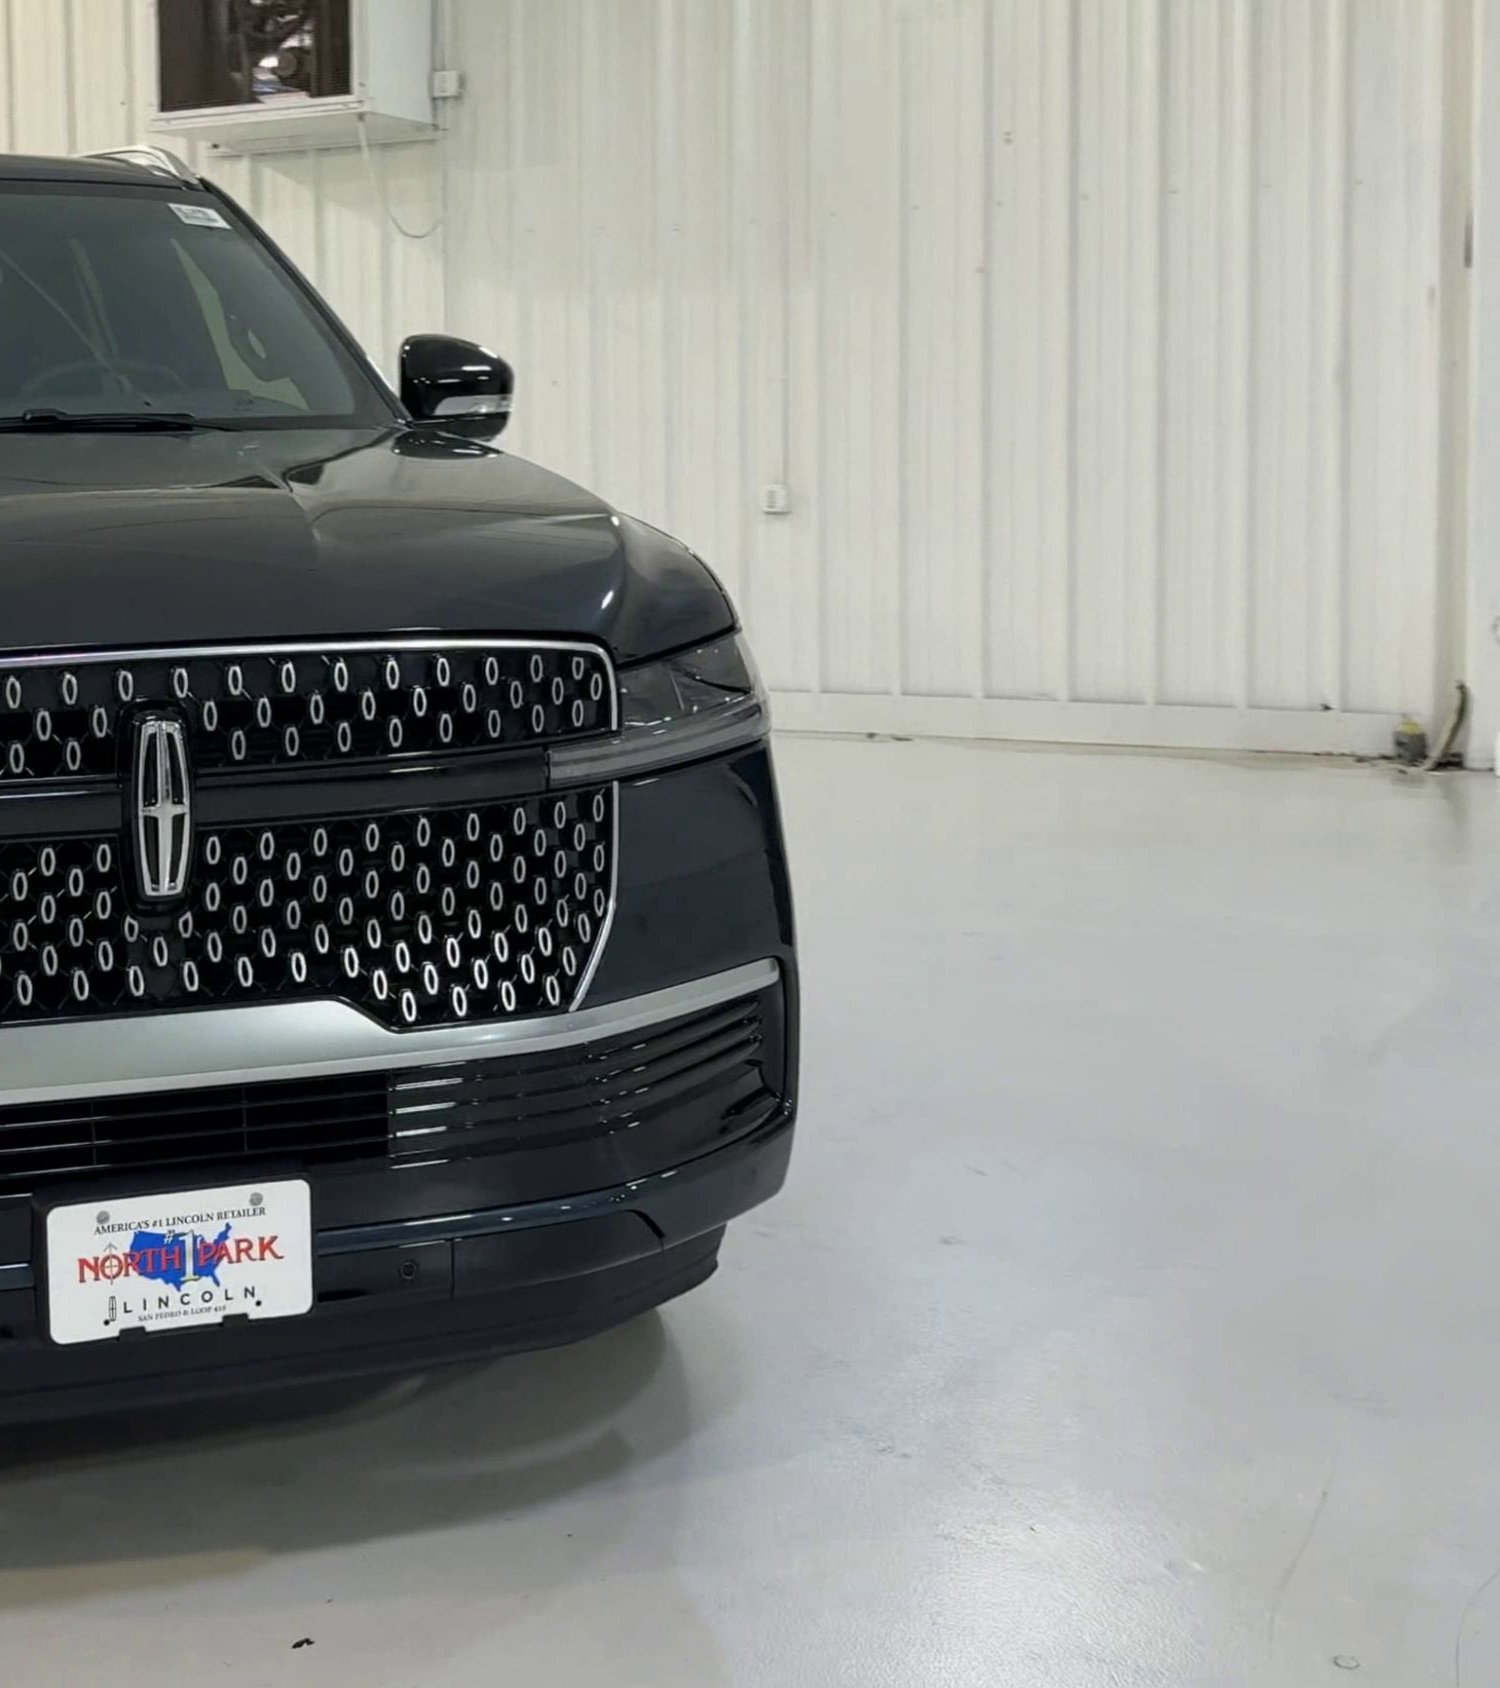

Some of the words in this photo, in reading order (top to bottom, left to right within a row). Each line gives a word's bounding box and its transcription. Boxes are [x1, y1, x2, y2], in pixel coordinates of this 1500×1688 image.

[94, 1219, 150, 1235] AMERICA'S
[152, 1219, 163, 1228] #1
[165, 1212, 214, 1227] LINCOLN
[217, 1206, 266, 1221] RETAILER
[77, 1245, 181, 1283] NORTH
[198, 1235, 284, 1267] PARK
[123, 1286, 256, 1313] LINCOLN
[138, 1312, 153, 1322] SAN
[155, 1309, 182, 1320] PEDRO
[190, 1306, 212, 1316] LOOP
